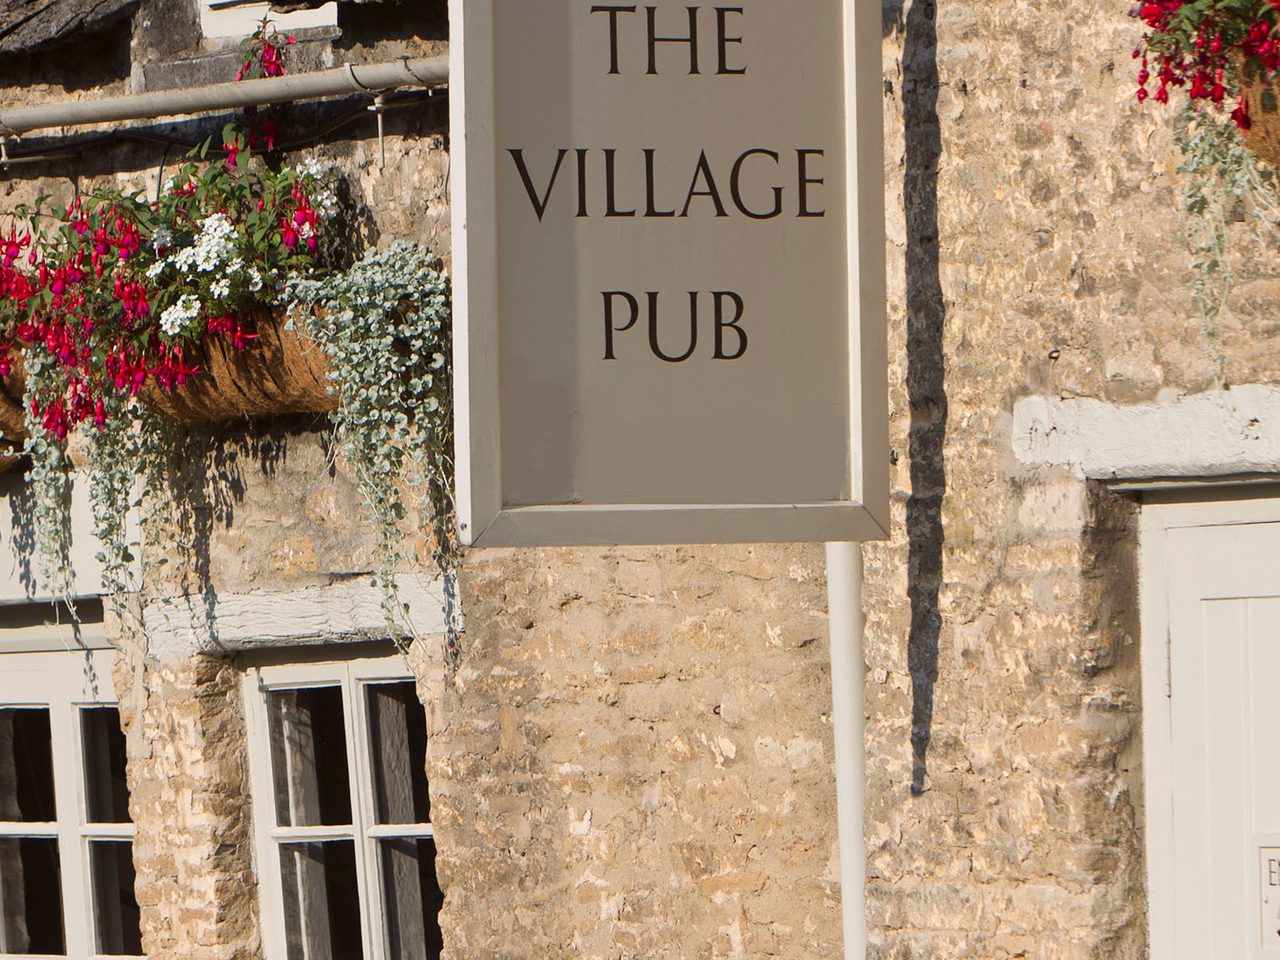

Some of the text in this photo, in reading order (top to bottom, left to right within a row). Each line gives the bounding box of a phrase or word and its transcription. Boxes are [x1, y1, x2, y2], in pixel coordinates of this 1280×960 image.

[590, 5, 747, 75] THE
[505, 148, 826, 223] VILLAGE
[600, 291, 748, 363] PUB
